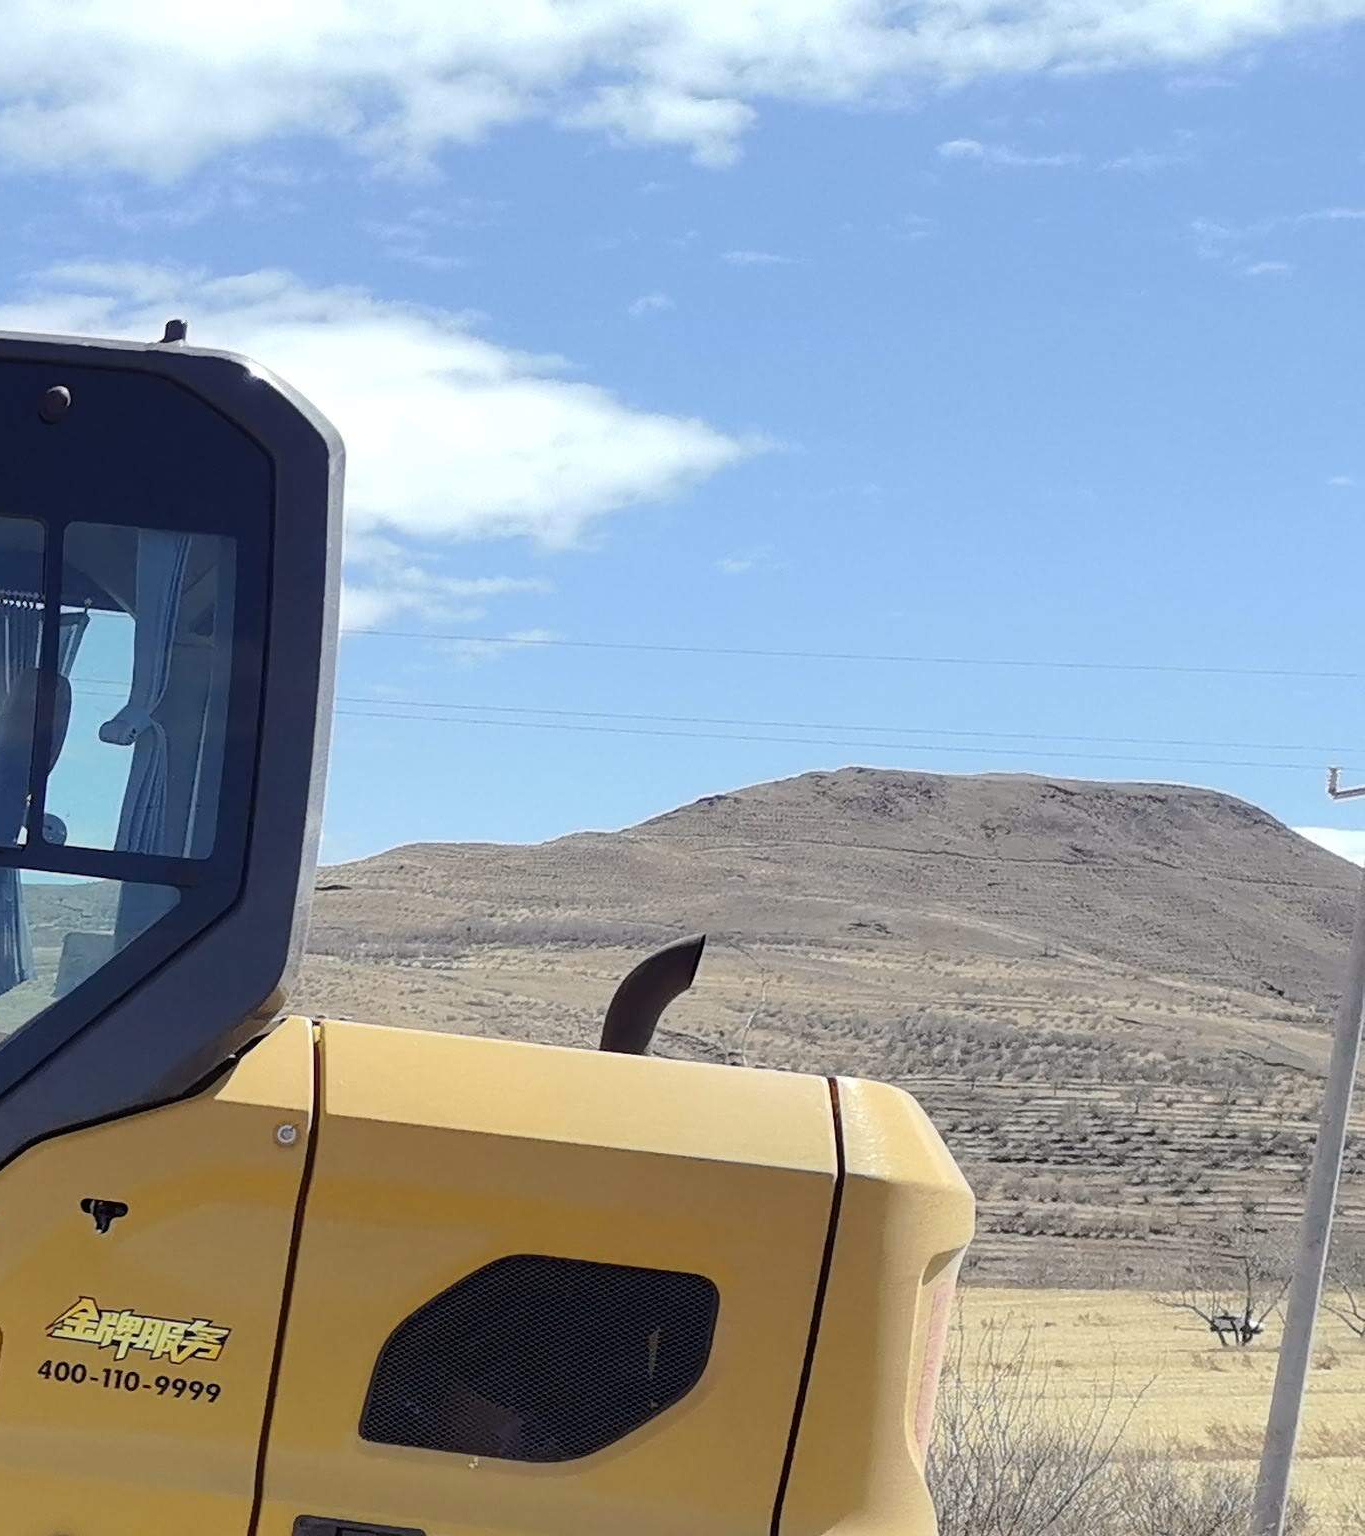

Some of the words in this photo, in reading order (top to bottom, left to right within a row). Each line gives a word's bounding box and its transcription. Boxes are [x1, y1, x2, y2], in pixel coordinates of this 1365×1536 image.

[45, 1296, 232, 1365] 金牌服务
[37, 1360, 222, 1403] 400-110-9999
